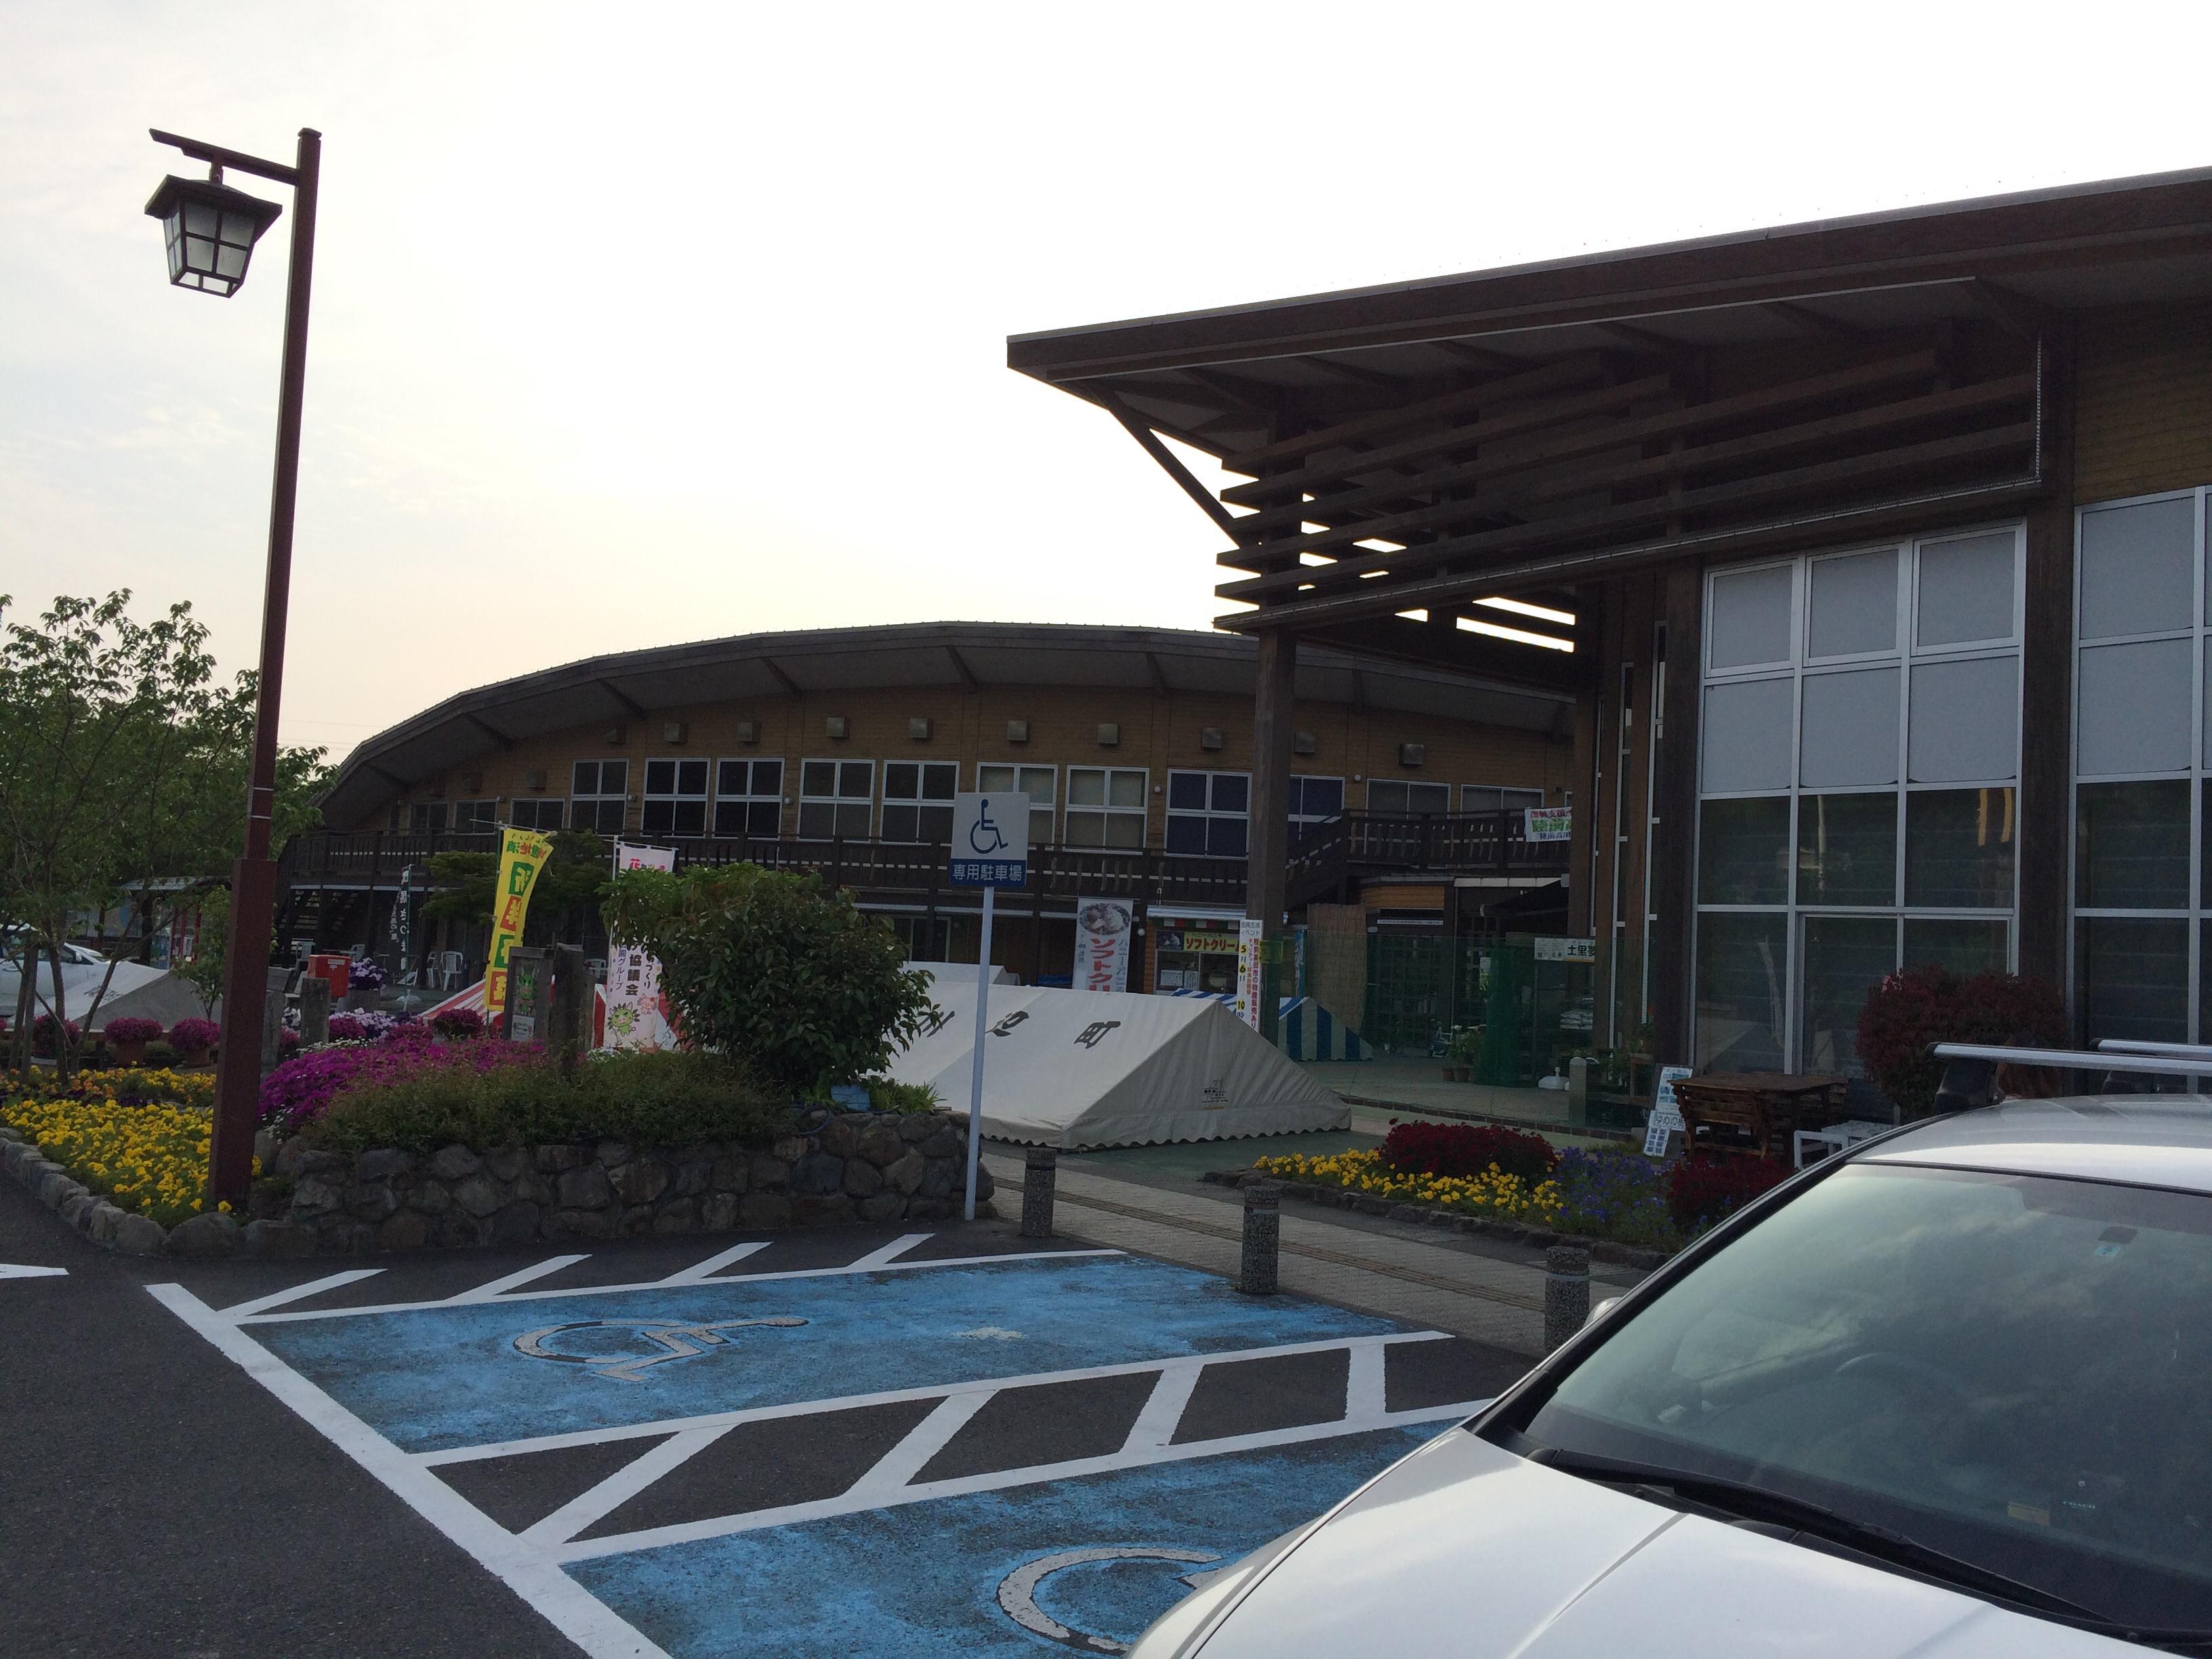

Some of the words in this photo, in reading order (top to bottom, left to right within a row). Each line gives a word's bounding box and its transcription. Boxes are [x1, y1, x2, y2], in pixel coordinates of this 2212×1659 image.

[952, 863, 1023, 882] 専用駐車場
